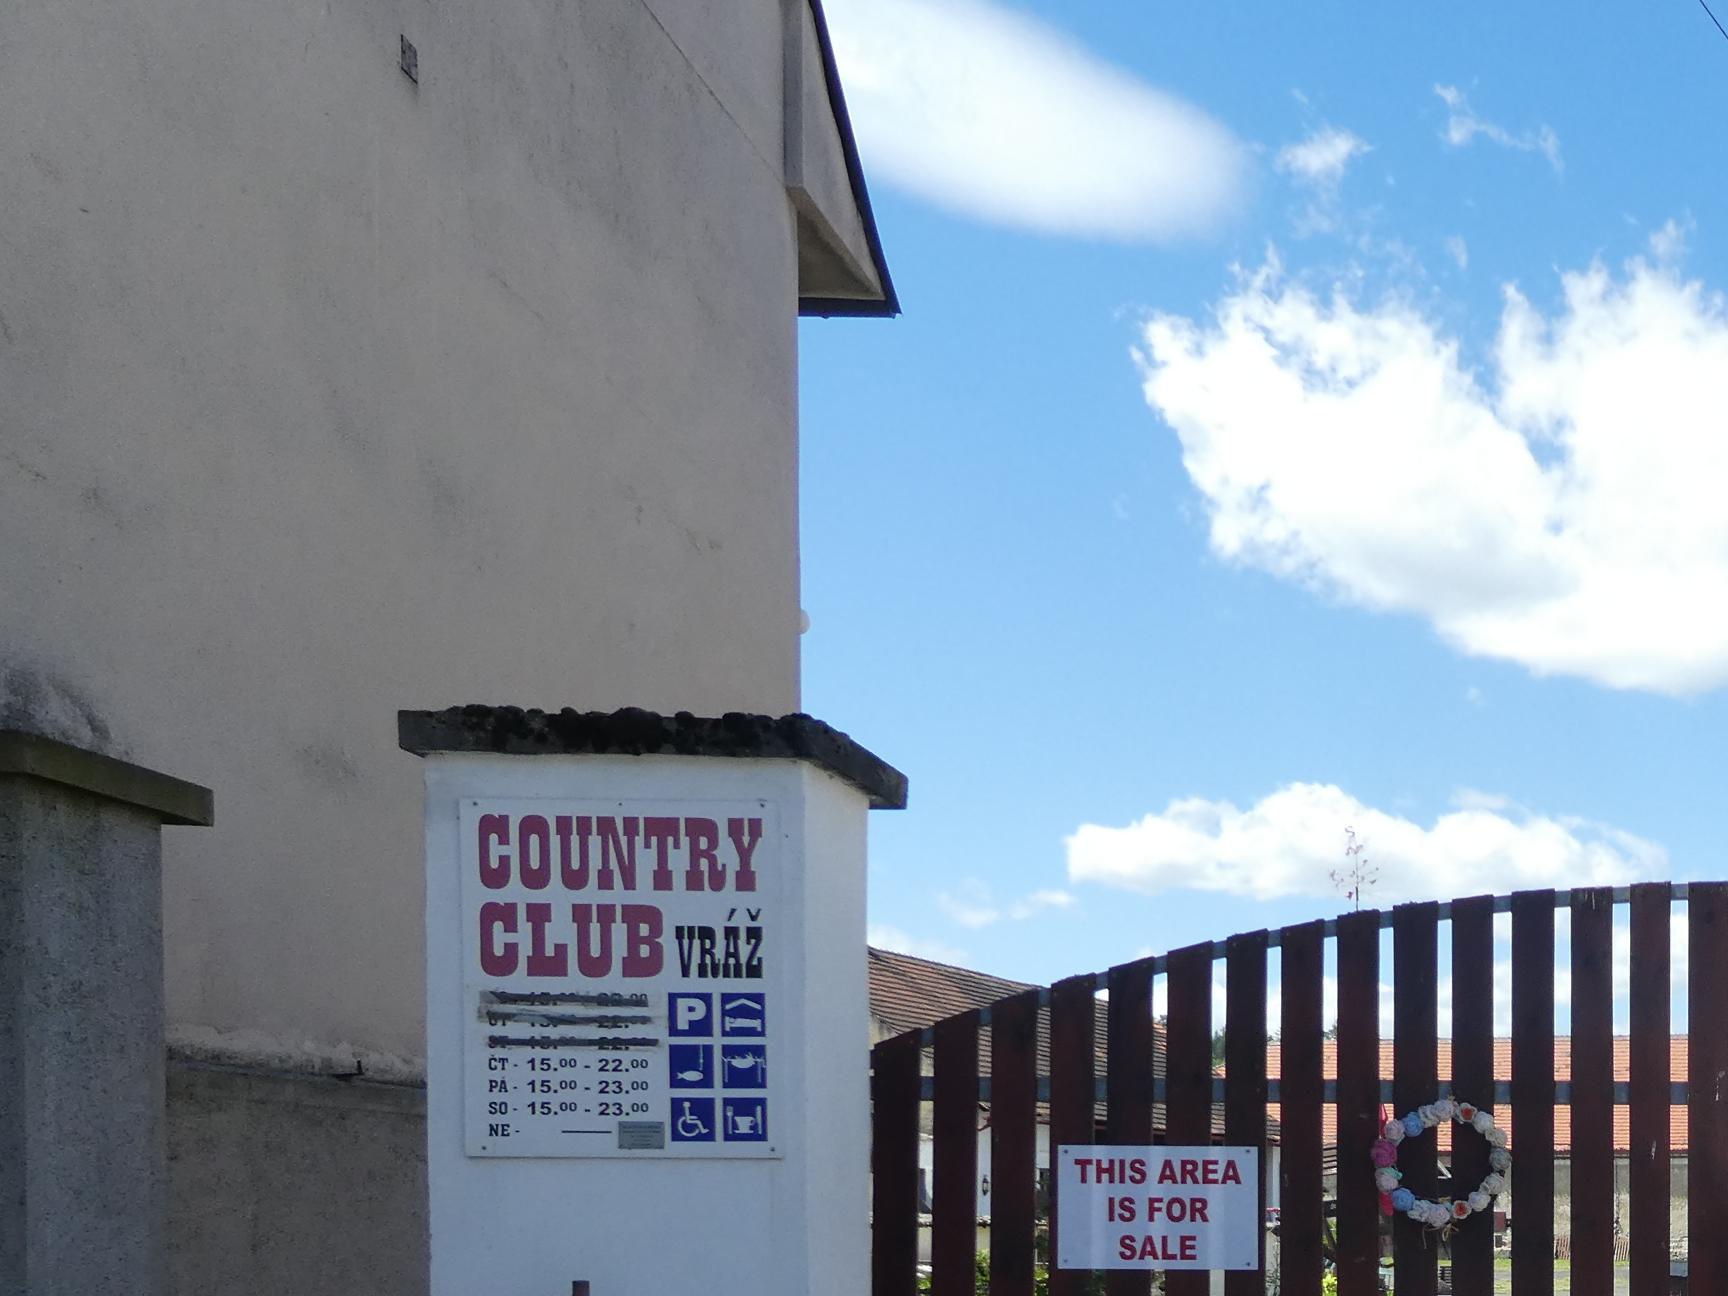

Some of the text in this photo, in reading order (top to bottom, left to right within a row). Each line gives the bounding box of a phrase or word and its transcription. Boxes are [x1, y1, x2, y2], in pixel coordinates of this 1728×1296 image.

[478, 813, 763, 892] COUNTRY
[479, 901, 763, 979] CLUB VRÁŽ
[675, 997, 707, 1031] P
[488, 1054, 509, 1071] ČT
[488, 1102, 509, 1116] SO
[489, 1123, 511, 1137] NE
[1074, 1159, 1242, 1185] THIS AREA
[1108, 1197, 1209, 1223] IS FOR
[1119, 1235, 1197, 1261] SALE
